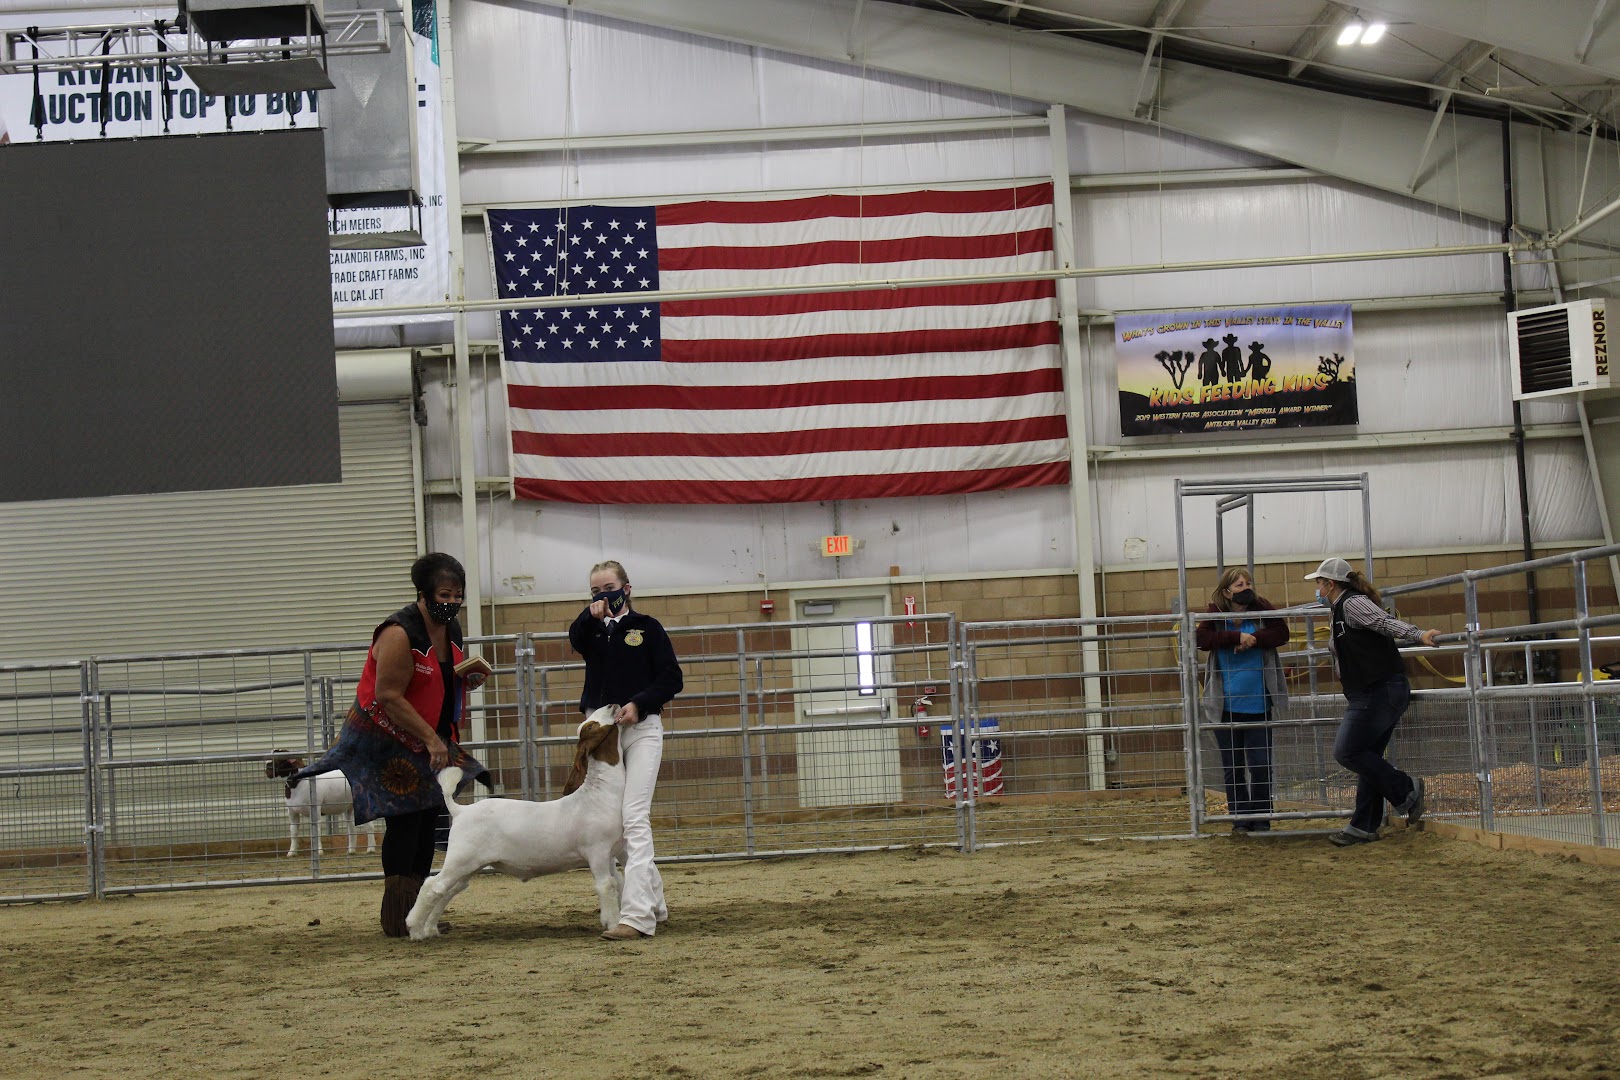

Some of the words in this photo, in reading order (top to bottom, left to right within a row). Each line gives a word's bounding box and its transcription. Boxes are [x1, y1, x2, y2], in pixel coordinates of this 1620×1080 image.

[30, 90, 152, 125] AUCTION
[161, 88, 216, 119] TOP
[429, 195, 443, 206] INC
[349, 218, 381, 230] MEIERS
[374, 249, 408, 262] FARMS,
[409, 248, 425, 260] INC
[359, 270, 386, 282] CRAFT
[388, 268, 419, 280] FARMS
[334, 291, 349, 302] ALL
[350, 290, 367, 301] CAL
[369, 289, 384, 300] JET
[1122, 327, 1155, 342] WHAT'S
[1190, 320, 1202, 329] IN
[1203, 319, 1221, 328] THIS
[1225, 317, 1255, 327] VALLEY
[1257, 316, 1281, 325] STAYS
[1283, 316, 1294, 325] IN
[1296, 318, 1312, 326] THE
[1314, 319, 1346, 329] VALLEY
[1593, 310, 1608, 375] REZNOR
[1149, 387, 1195, 407] KIDS
[1200, 378, 1277, 403] FEEDING
[1282, 373, 1329, 393] KIDS
[1153, 412, 1181, 421] WESTERN
[1182, 411, 1200, 420] FAIRS
[1202, 409, 1243, 418] ASSOCIATION
[1279, 406, 1302, 415] AWARD
[1204, 420, 1235, 430] ANTELOPE
[1237, 419, 1259, 427] VALLEY
[1260, 417, 1277, 426] FAIR
[827, 536, 848, 553] EXIT
